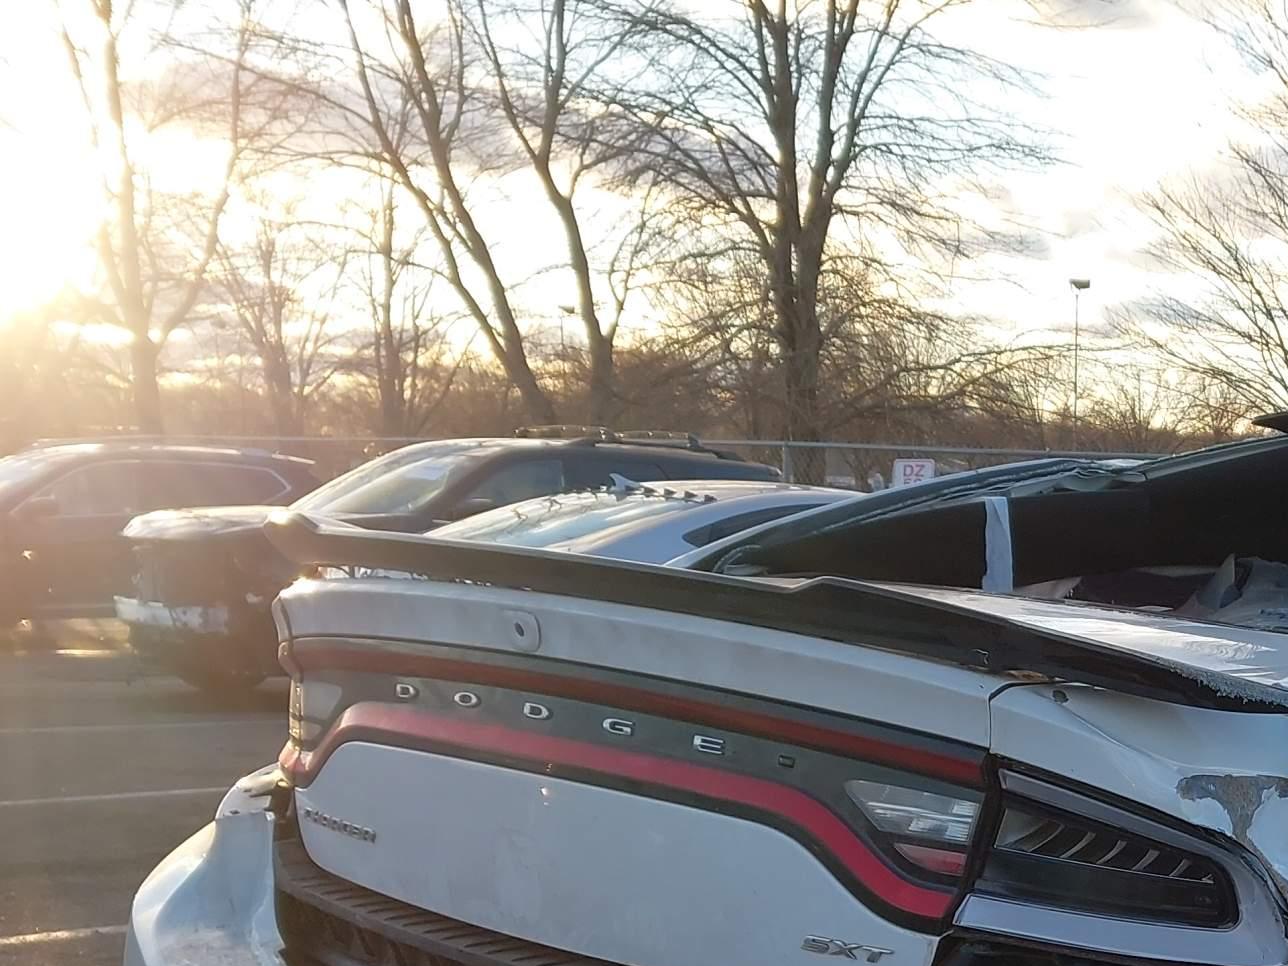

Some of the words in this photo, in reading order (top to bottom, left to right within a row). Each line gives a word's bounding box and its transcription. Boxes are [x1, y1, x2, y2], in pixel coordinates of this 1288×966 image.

[903, 464, 925, 477] DZ
[395, 683, 726, 755] DODGE
[800, 935, 895, 963] SXT
